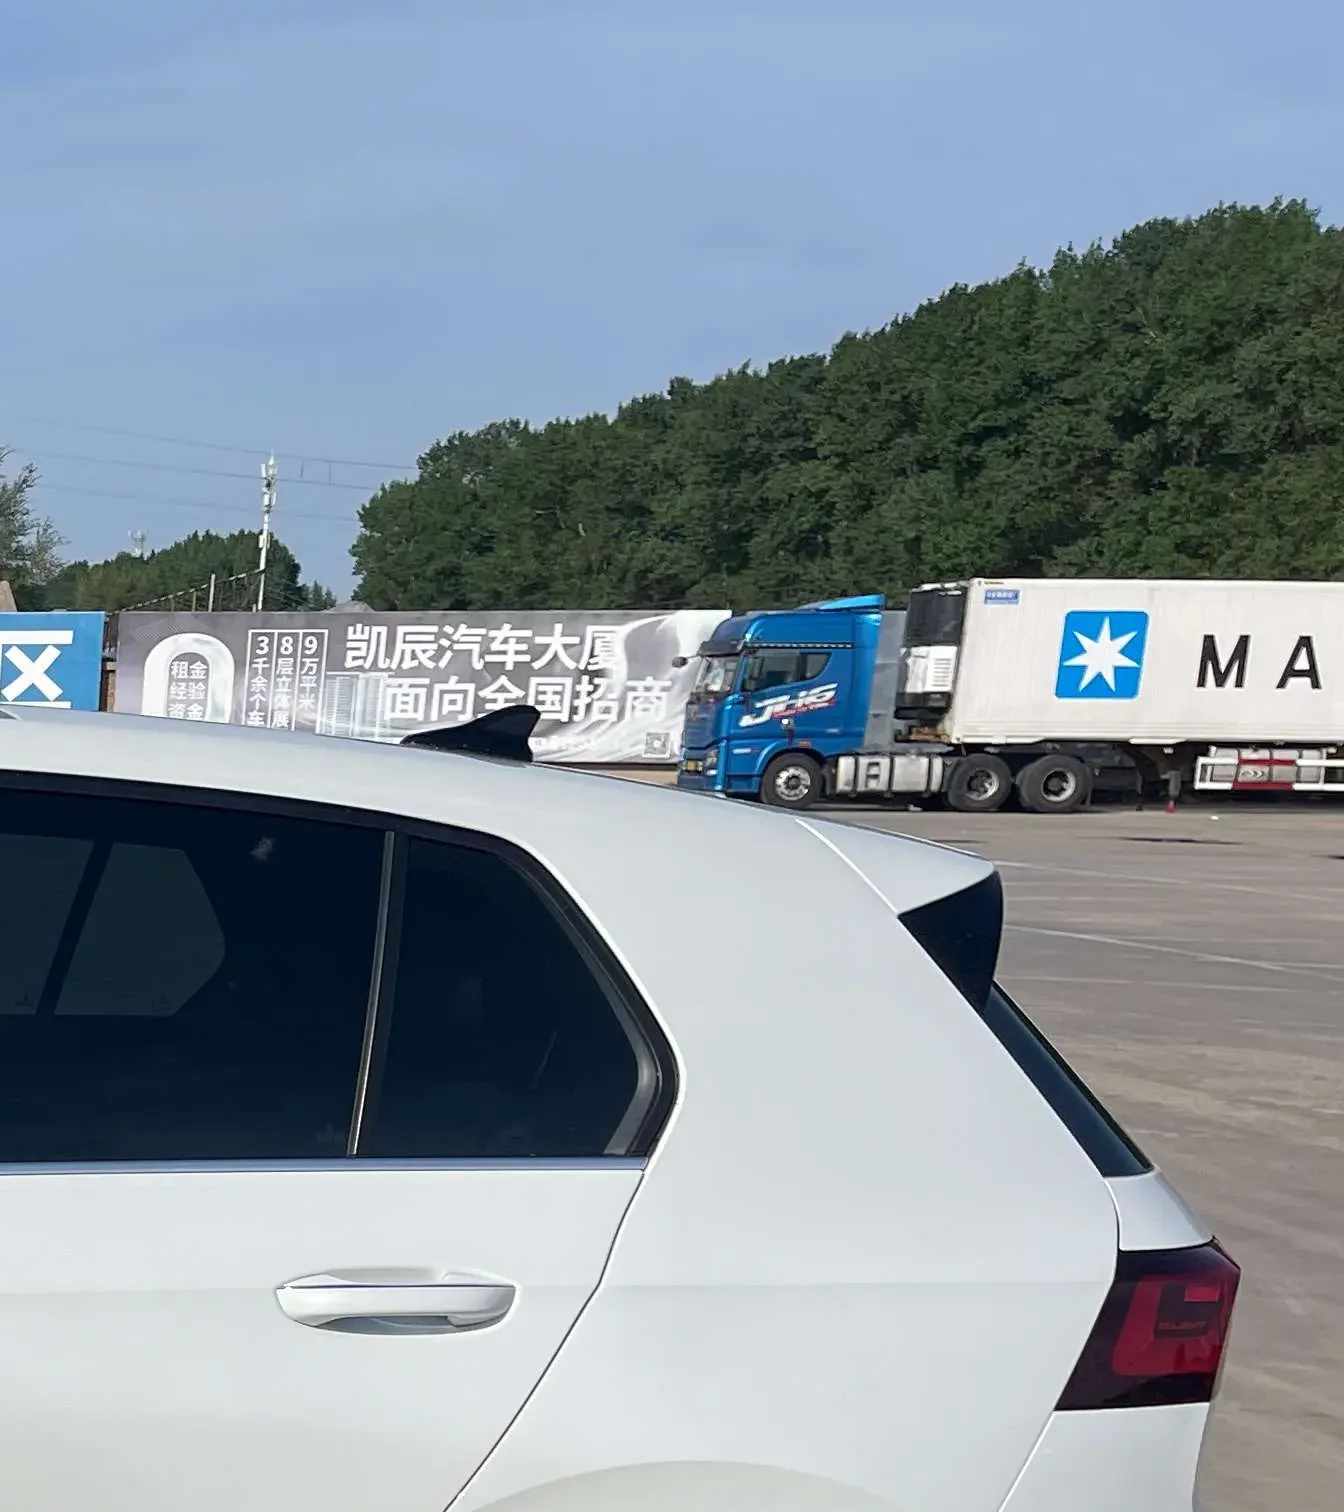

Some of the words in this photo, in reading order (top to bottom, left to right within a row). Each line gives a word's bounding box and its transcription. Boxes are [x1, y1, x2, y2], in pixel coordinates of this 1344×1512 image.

[170, 660, 209, 680] 租金
[344, 623, 621, 672] 凯辰汽车大厦
[169, 681, 207, 701] 经验
[299, 635, 320, 711] 9万平米
[384, 675, 672, 723] 面向全国招商
